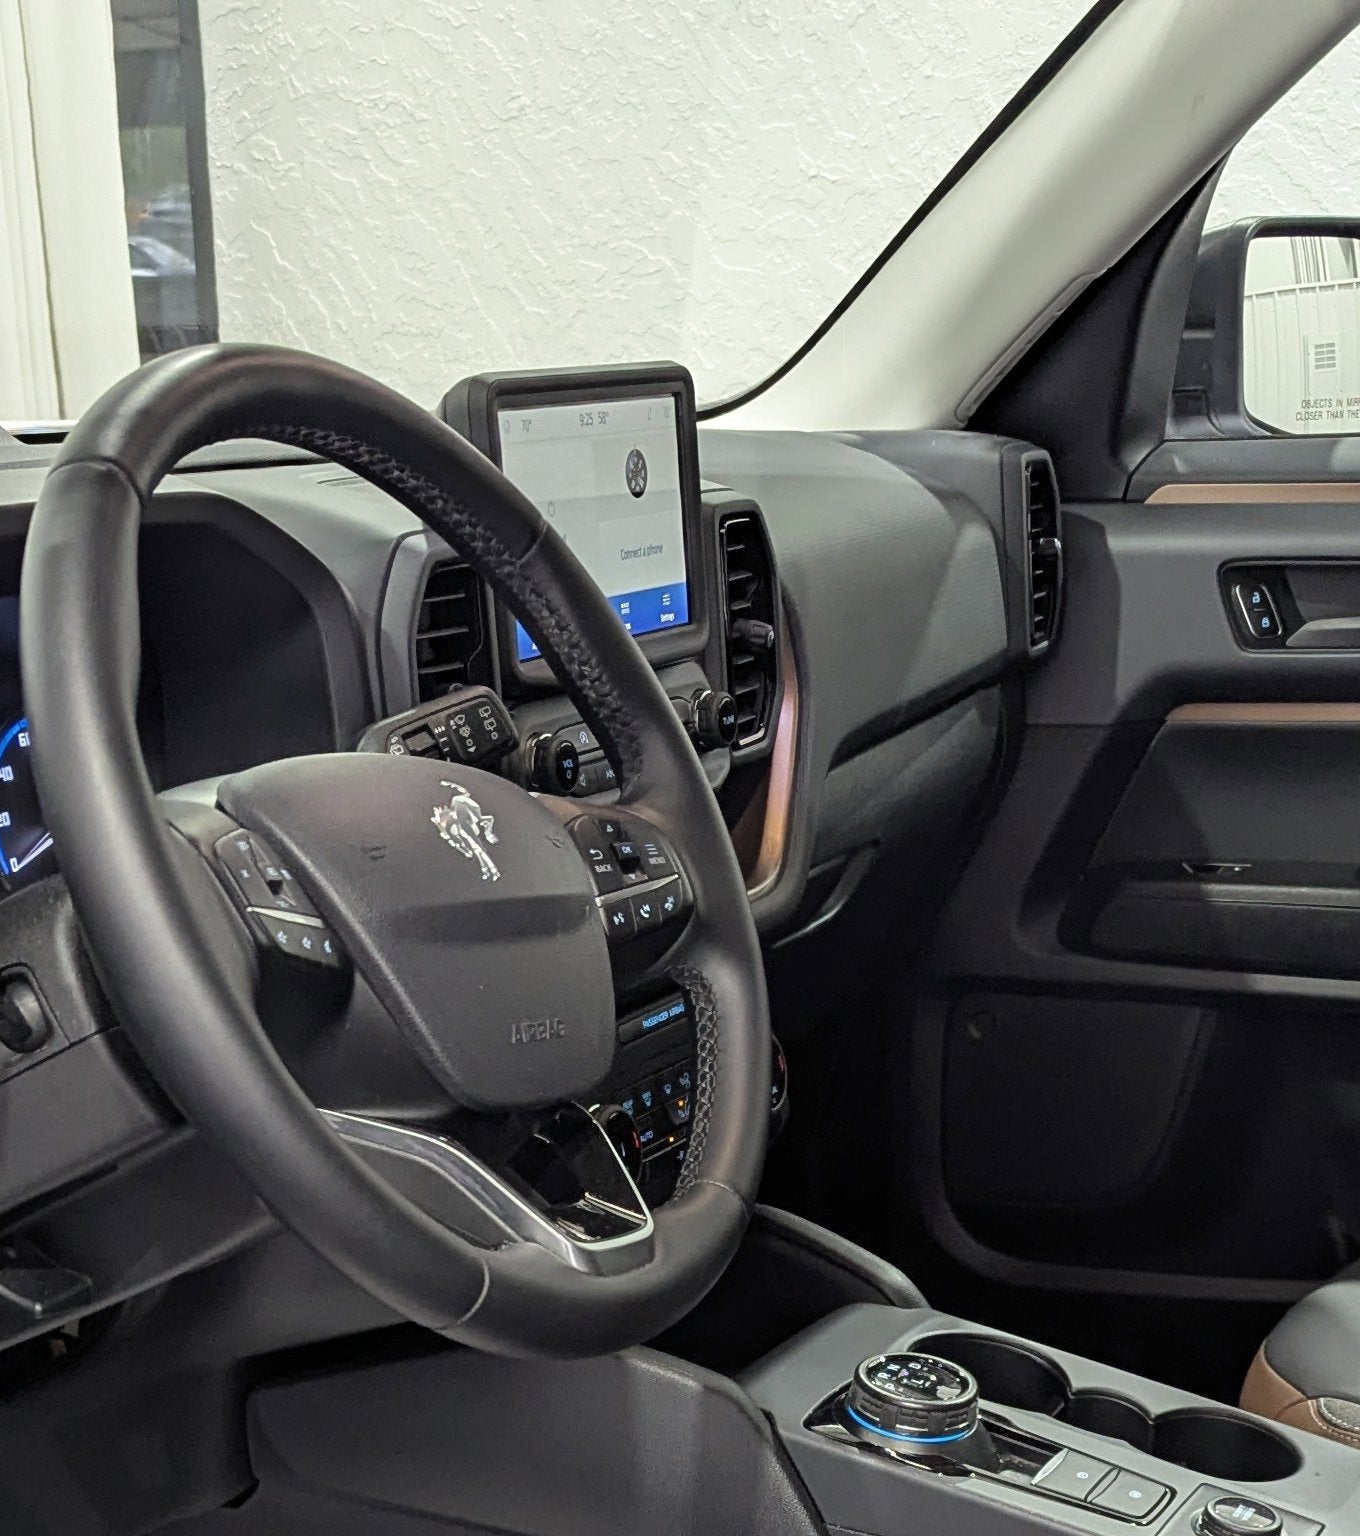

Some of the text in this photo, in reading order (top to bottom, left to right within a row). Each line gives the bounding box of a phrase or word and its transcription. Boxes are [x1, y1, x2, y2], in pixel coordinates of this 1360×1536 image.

[1301, 398, 1333, 409] OBJECTS
[1336, 398, 1343, 408] IN
[1295, 411, 1323, 421] CLOSER
[1326, 410, 1345, 420] THAN
[620, 546, 642, 561] Connect
[646, 543, 664, 558] phone
[9, 857, 19, 873] 0
[594, 863, 614, 873] BACK
